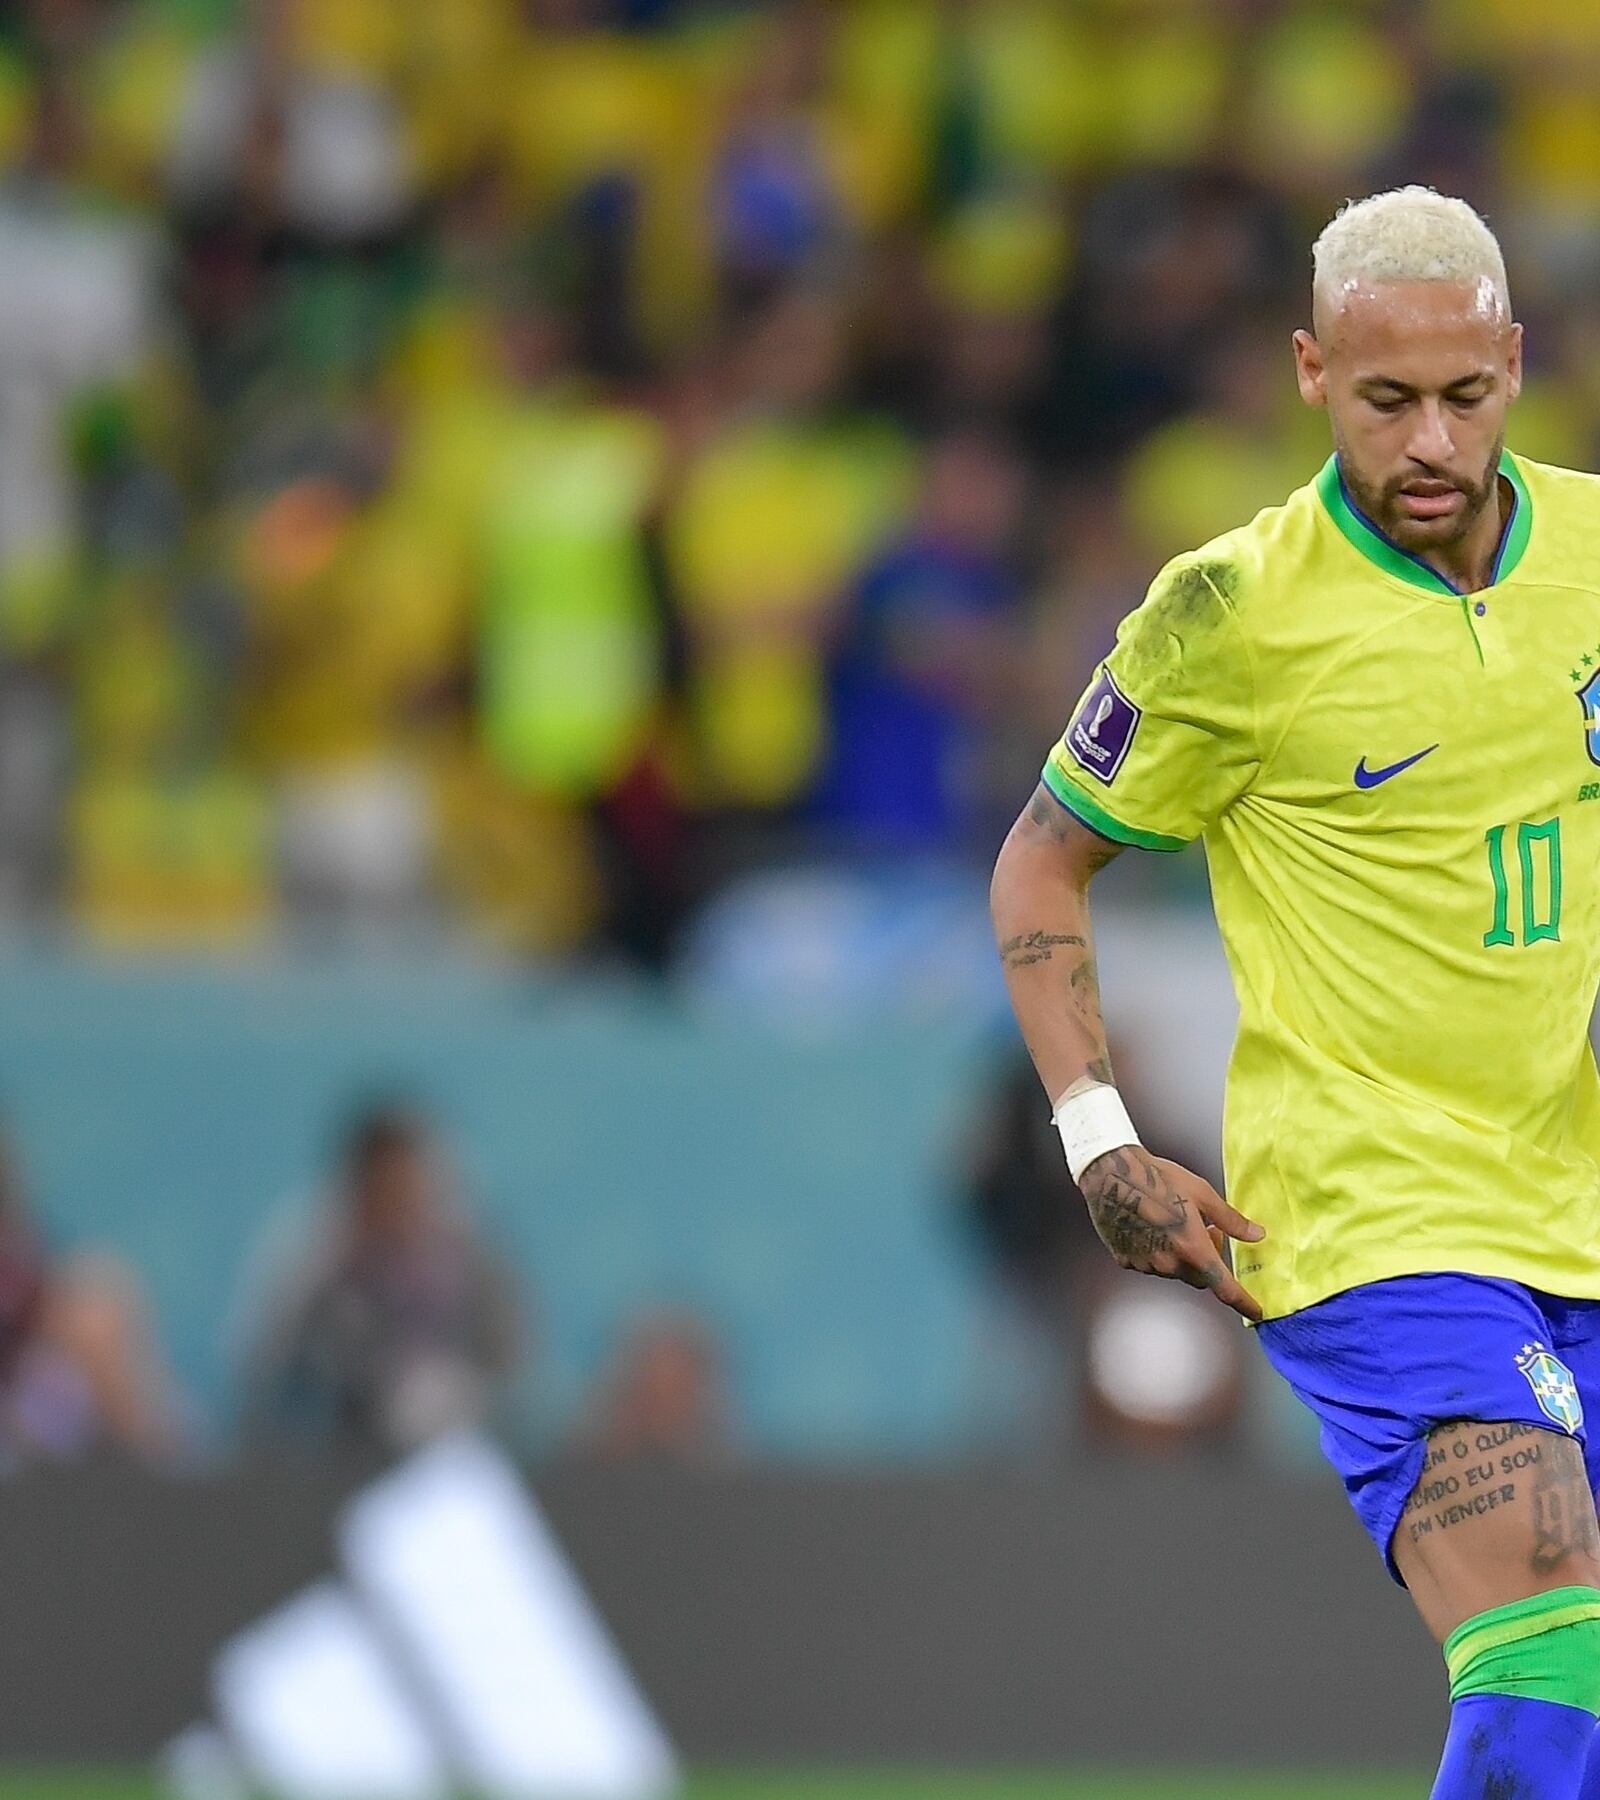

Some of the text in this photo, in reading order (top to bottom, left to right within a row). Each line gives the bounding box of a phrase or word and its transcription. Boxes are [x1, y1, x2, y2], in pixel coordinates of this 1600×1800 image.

[1483, 815, 1562, 948] 10
[1464, 1461, 1495, 1487] EU
[1501, 1443, 1542, 1474] SOU
[1434, 1483, 1516, 1529] VENCER
